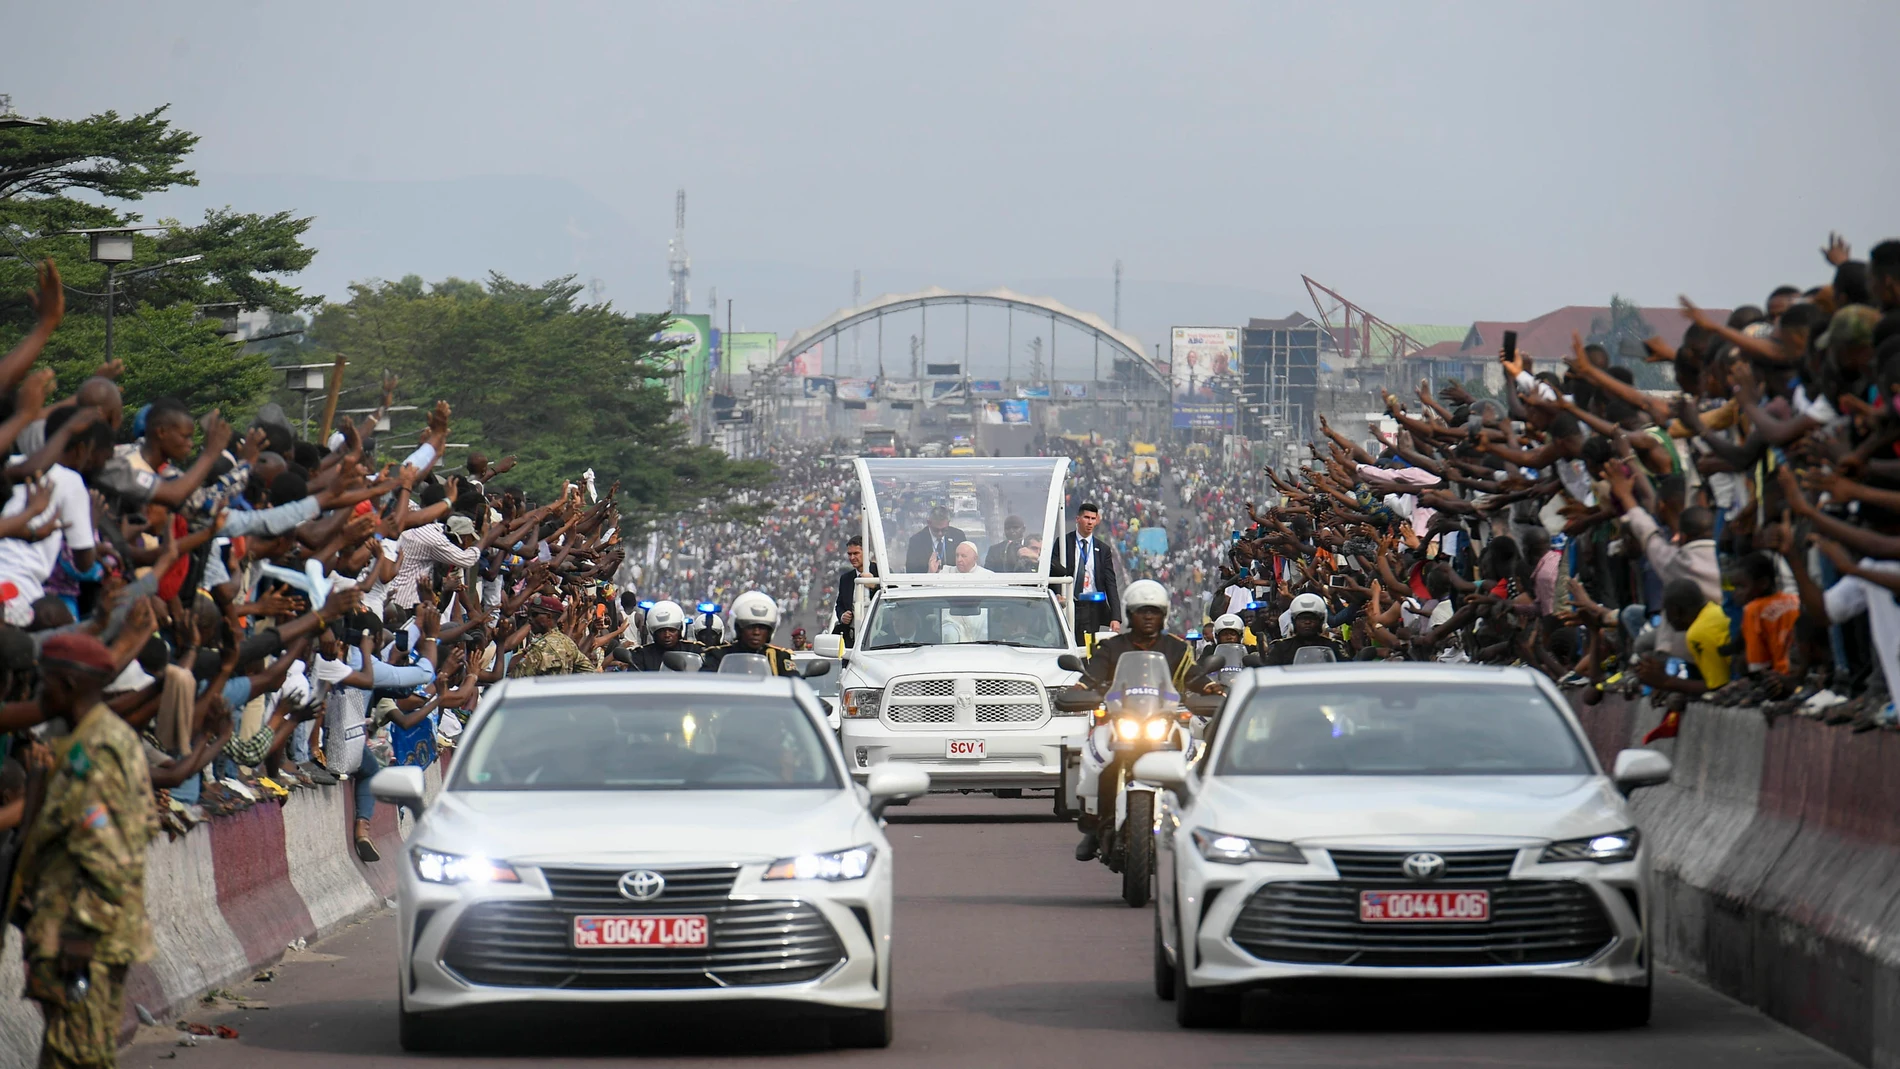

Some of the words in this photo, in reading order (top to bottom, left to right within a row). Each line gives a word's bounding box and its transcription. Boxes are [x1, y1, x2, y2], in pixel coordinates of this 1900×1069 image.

[1125, 687, 1159, 696] POLICE
[950, 742, 974, 753] SCV
[979, 742, 983, 753] 1
[1387, 895, 1438, 917] 0044
[1442, 895, 1482, 917] LOG
[603, 919, 655, 943] 0047
[659, 919, 701, 943] LOG
